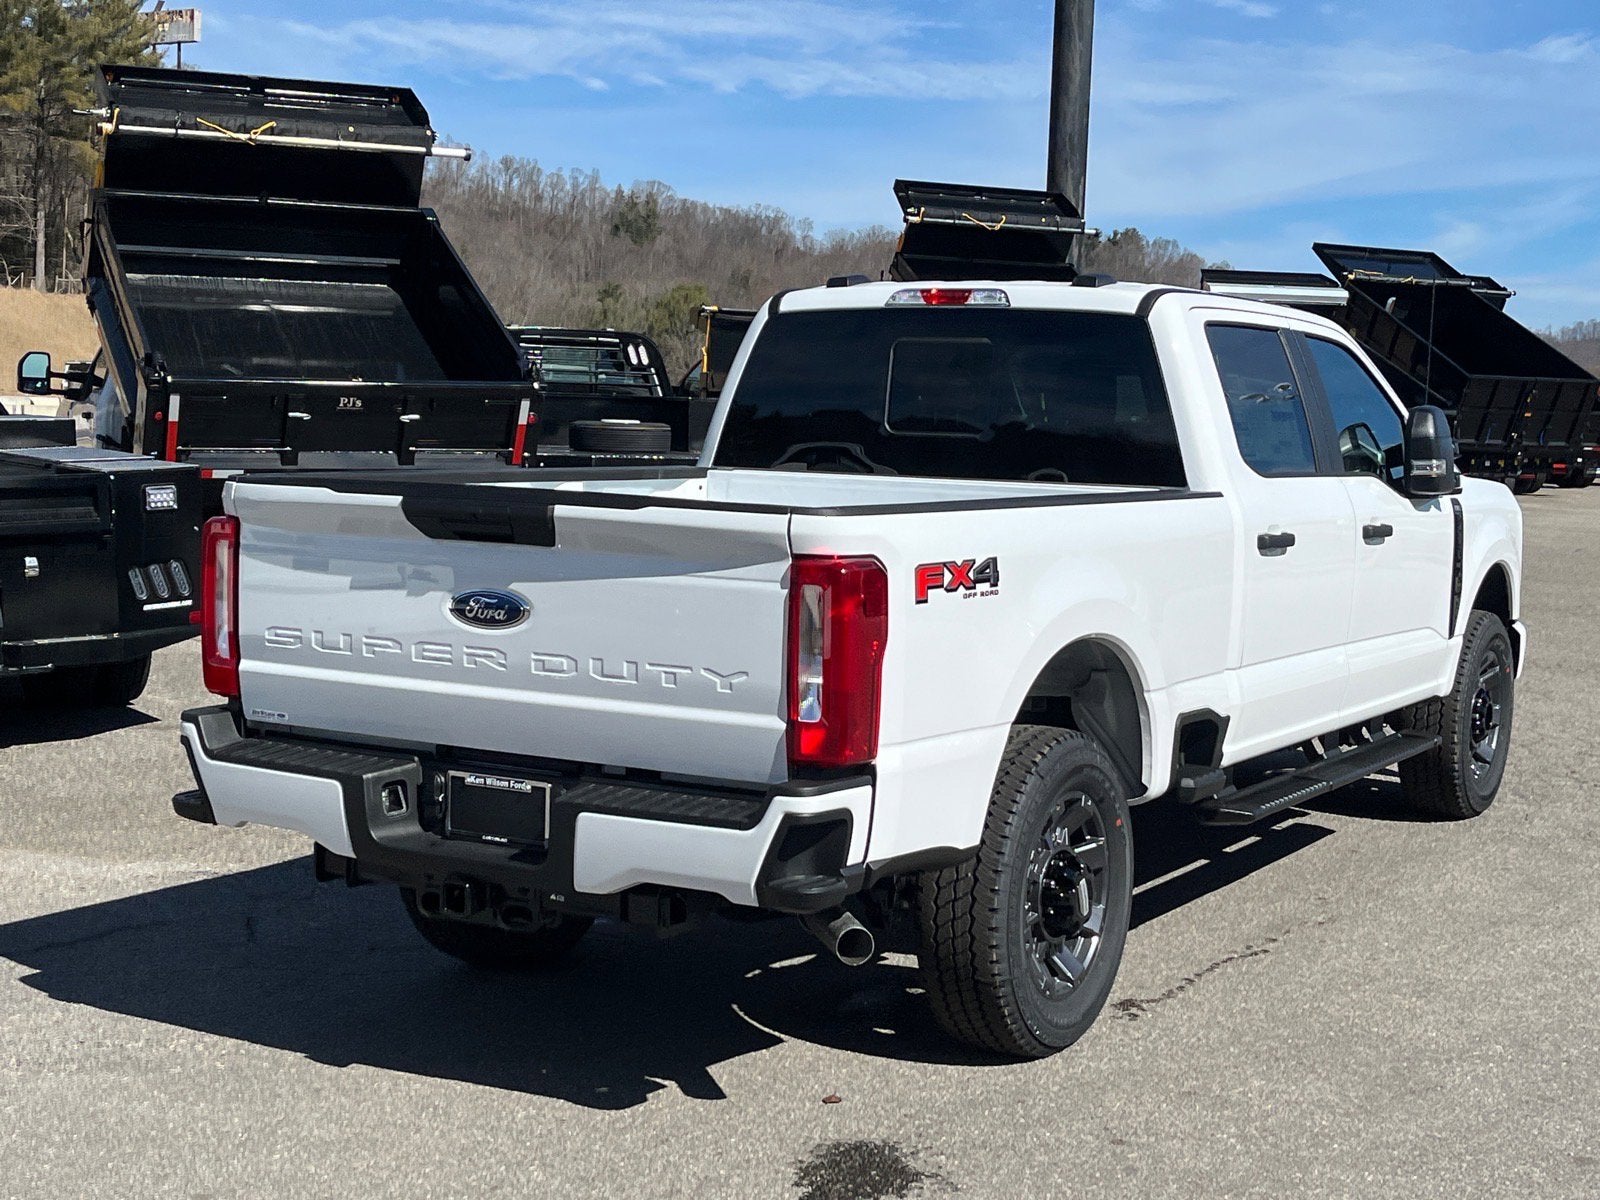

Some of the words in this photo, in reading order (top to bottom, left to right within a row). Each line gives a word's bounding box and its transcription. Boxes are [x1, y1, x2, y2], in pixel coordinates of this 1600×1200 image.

[339, 397, 362, 407] PJ's
[914, 556, 999, 605] FX4
[980, 589, 999, 597] ROAD
[465, 596, 508, 620] Ford
[264, 625, 508, 671] SUPER
[531, 651, 748, 693] DUTY
[470, 775, 484, 785] Ken
[486, 777, 509, 788] Wilson
[510, 780, 526, 791] Ford
